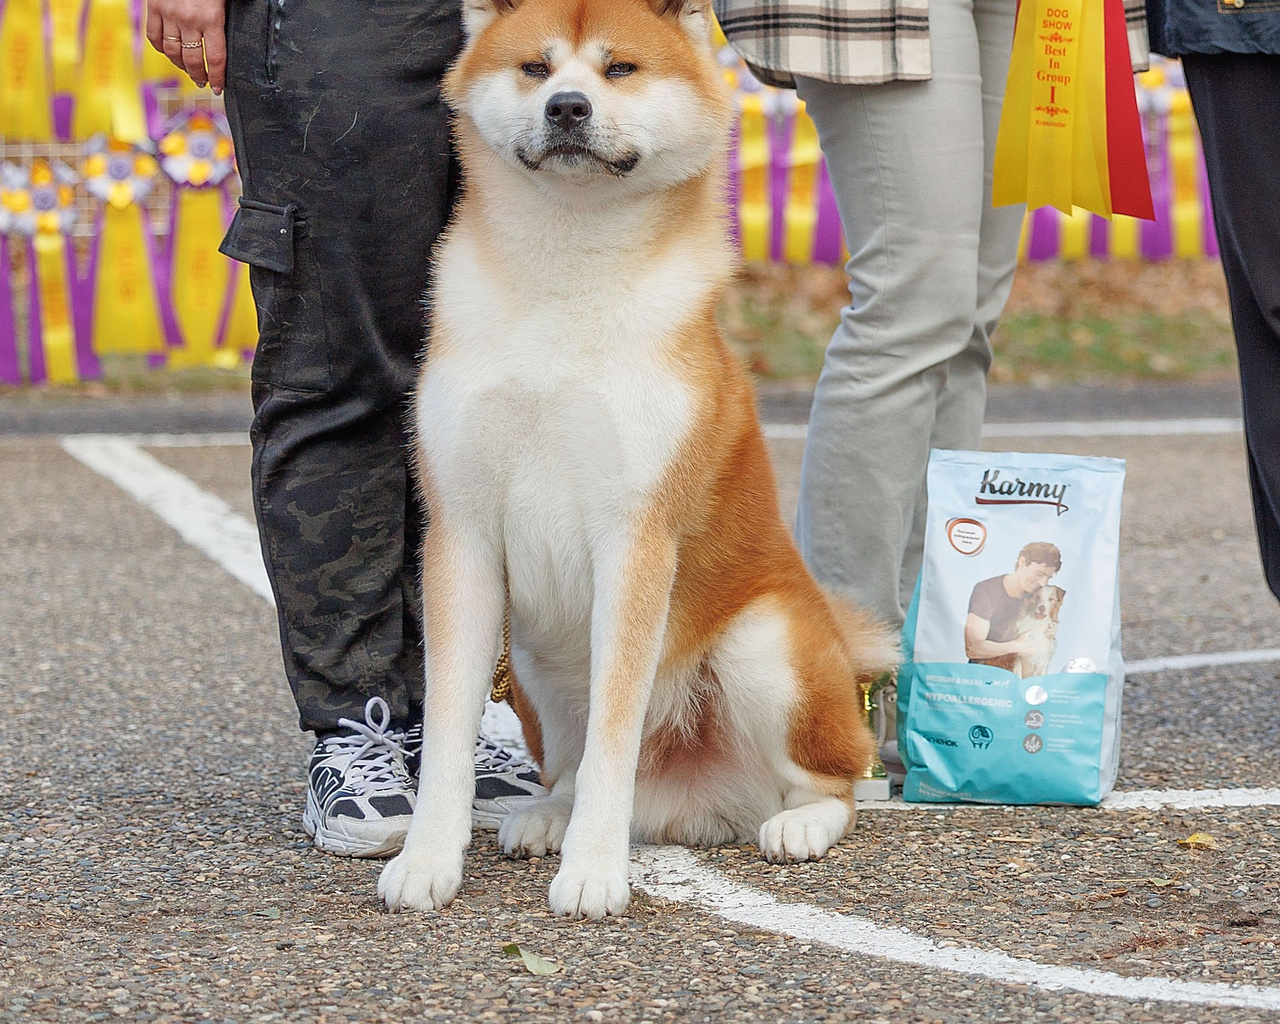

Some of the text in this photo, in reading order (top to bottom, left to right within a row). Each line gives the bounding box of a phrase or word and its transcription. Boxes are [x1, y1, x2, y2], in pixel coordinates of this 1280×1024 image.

[1047, 8, 1069, 18] DOG
[1042, 19, 1072, 30] SHOW
[1044, 45, 1066, 56] Best
[1049, 58, 1060, 69] In
[1036, 70, 1071, 86] Group
[980, 469, 1067, 516] Karmy
[924, 692, 1013, 708] HYPOALLERGENIC
